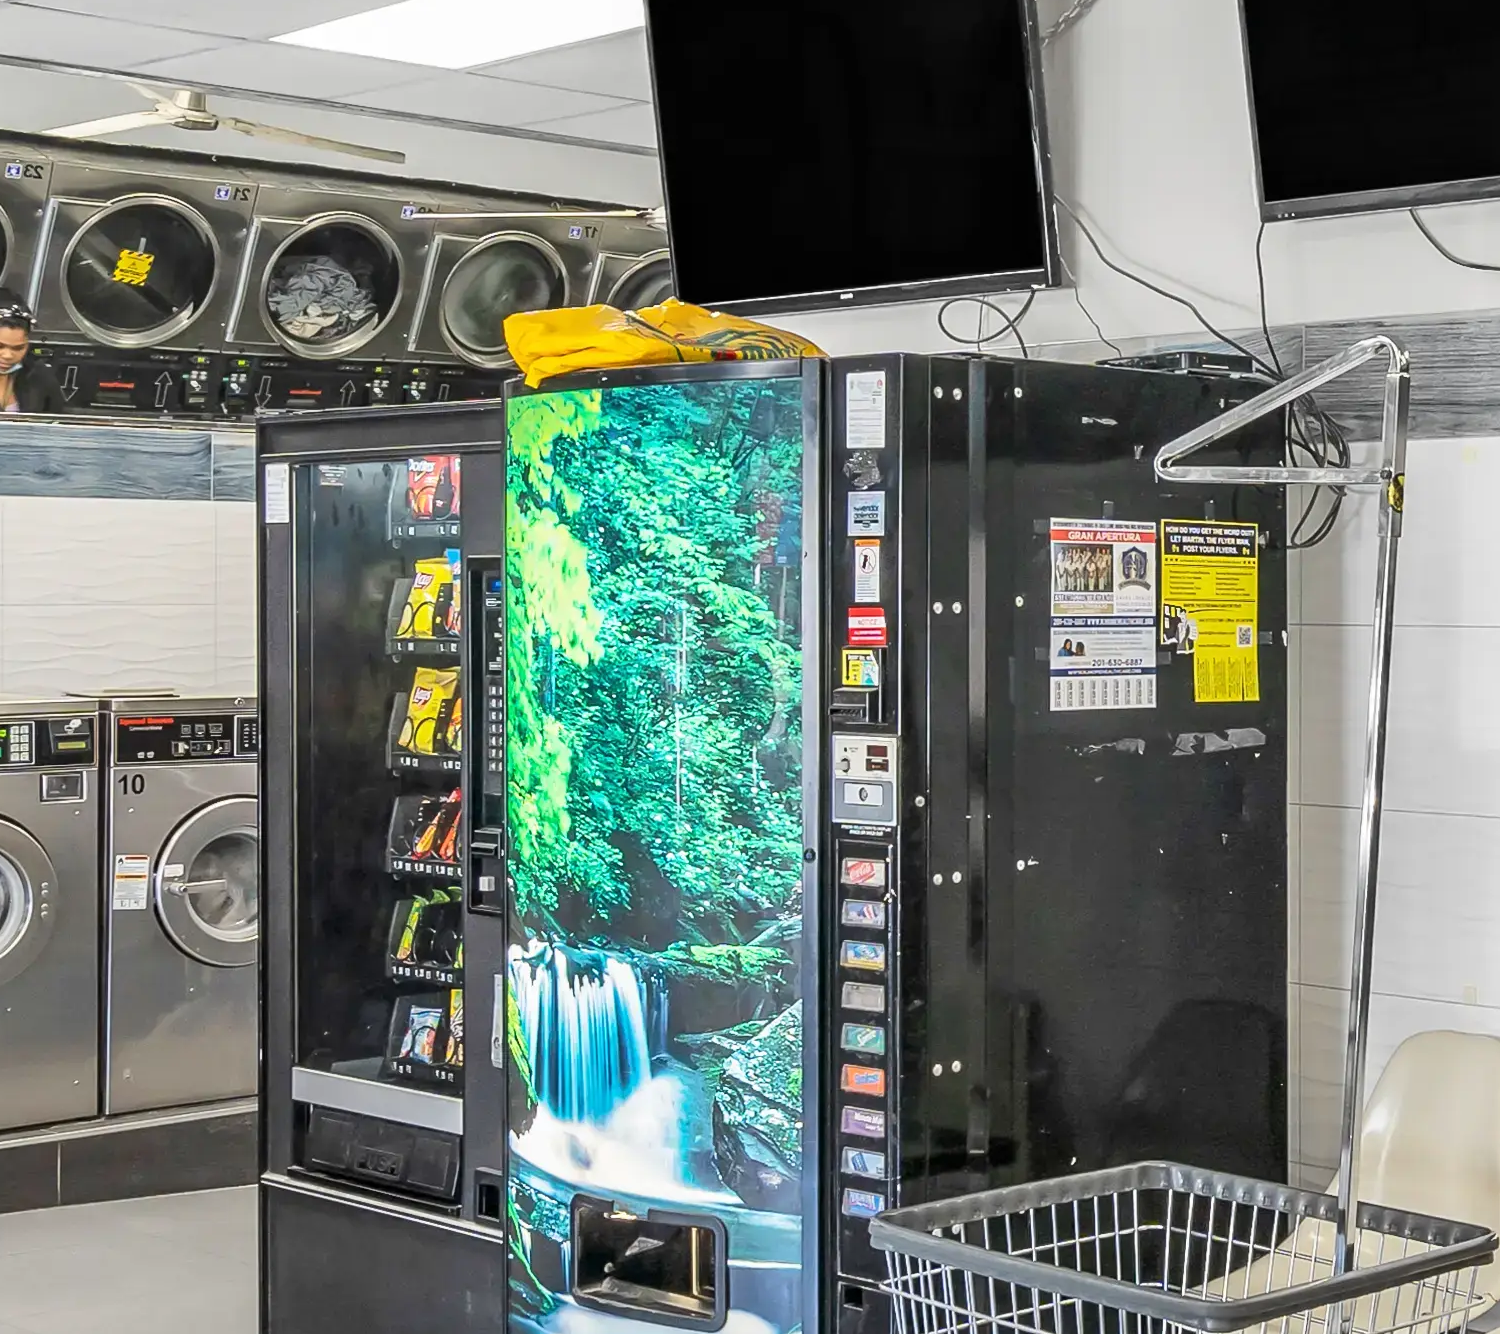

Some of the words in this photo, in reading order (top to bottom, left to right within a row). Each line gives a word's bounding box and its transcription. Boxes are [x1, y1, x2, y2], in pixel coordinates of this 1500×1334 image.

[1068, 531, 1094, 541] GRAN
[1096, 532, 1141, 542] APERTURA
[118, 774, 146, 795] 10
